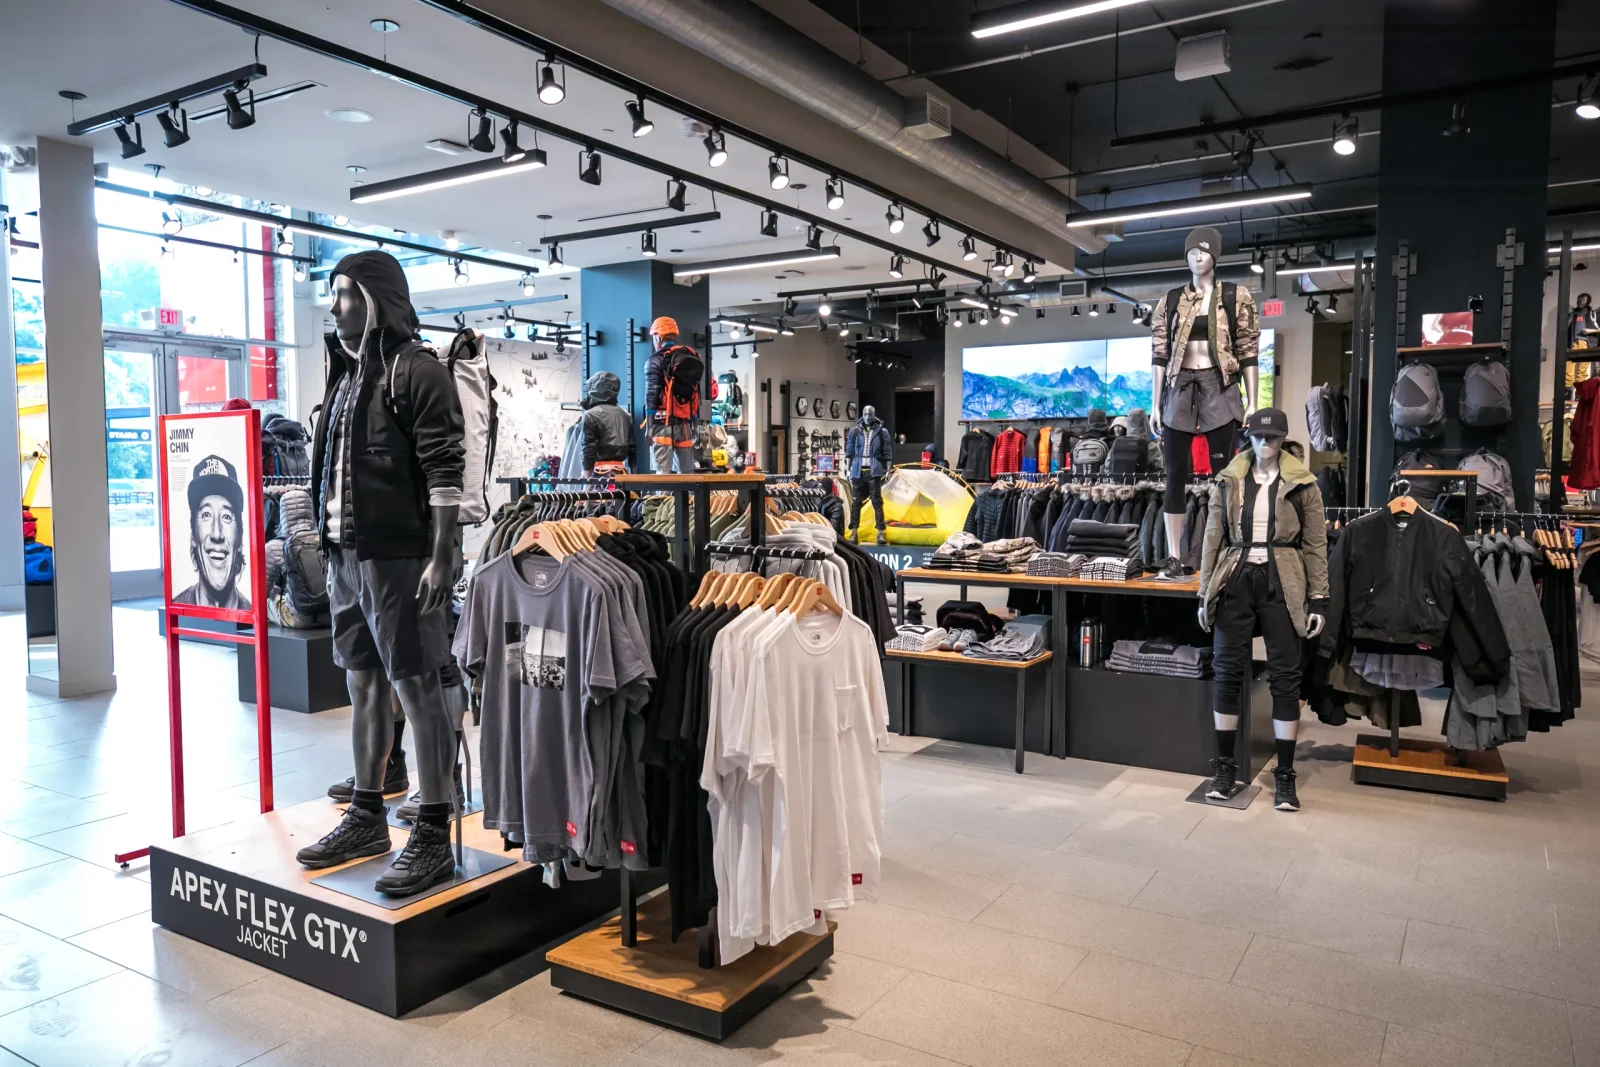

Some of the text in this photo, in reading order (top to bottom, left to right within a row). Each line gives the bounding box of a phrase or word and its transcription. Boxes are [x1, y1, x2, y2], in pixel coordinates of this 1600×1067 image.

[1264, 301, 1283, 316] EXIT
[160, 309, 179, 324] EXIT
[169, 428, 194, 440] JIMMY
[170, 442, 189, 453] CHIN
[205, 458, 219, 467] THE
[903, 554, 913, 570] 2
[170, 867, 229, 916] APEX
[235, 887, 297, 940] FLEX
[236, 925, 289, 959] JACKET
